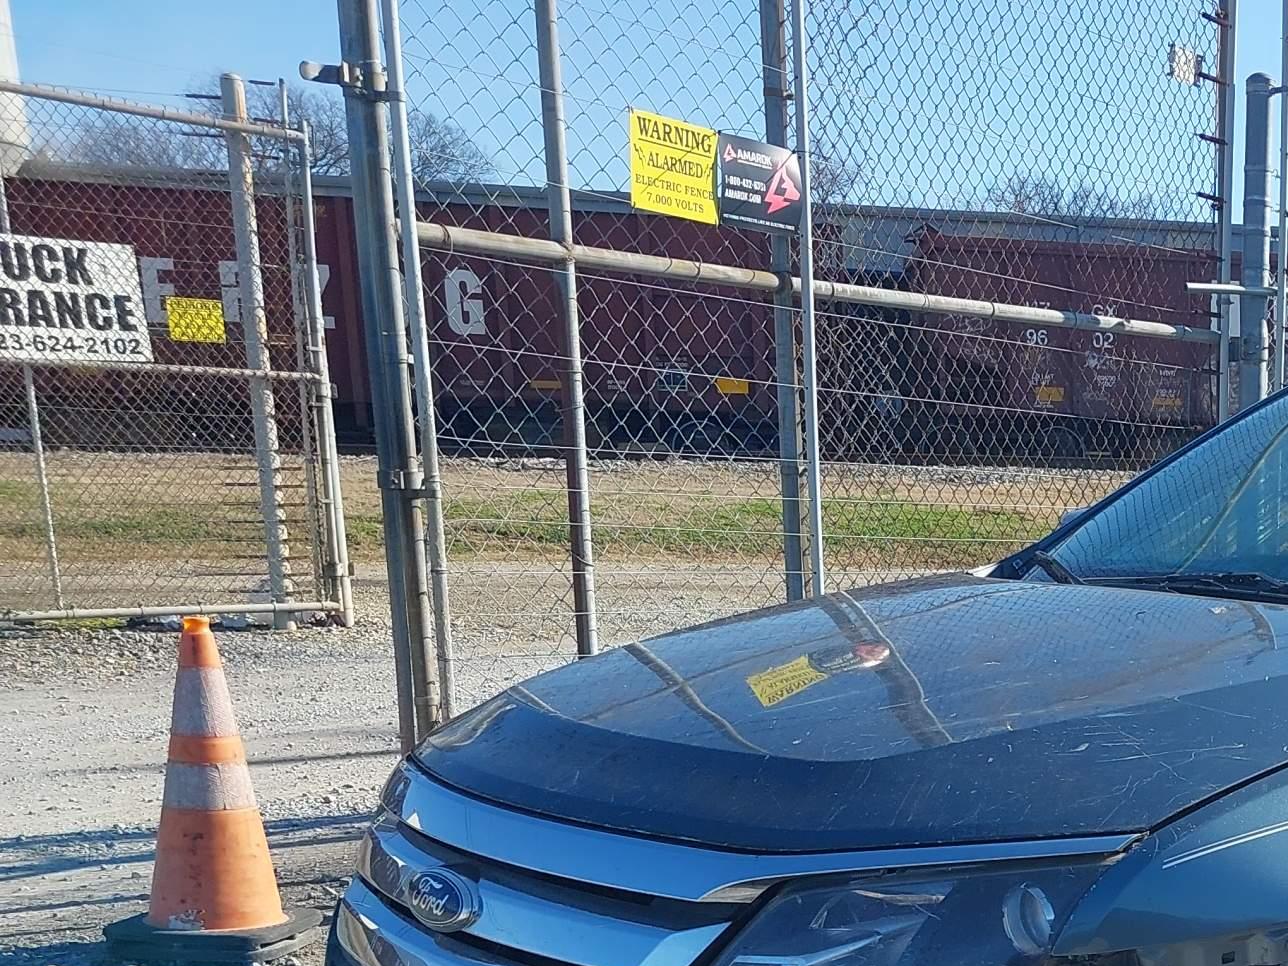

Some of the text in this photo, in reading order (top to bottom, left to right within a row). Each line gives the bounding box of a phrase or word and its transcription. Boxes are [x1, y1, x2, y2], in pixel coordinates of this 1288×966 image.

[637, 116, 712, 154] WARNING
[648, 152, 703, 179] ALARMED
[737, 149, 773, 166] AMAROK
[635, 174, 714, 201] ELECTRIC FENCE
[646, 191, 704, 214] 7,000 VOLTS
[0, 241, 94, 285] UCK
[0, 287, 139, 332] RANCE
[0, 334, 142, 354] 23-624-2102
[1026, 329, 1114, 348] 96 02
[412, 876, 449, 915] Ford
